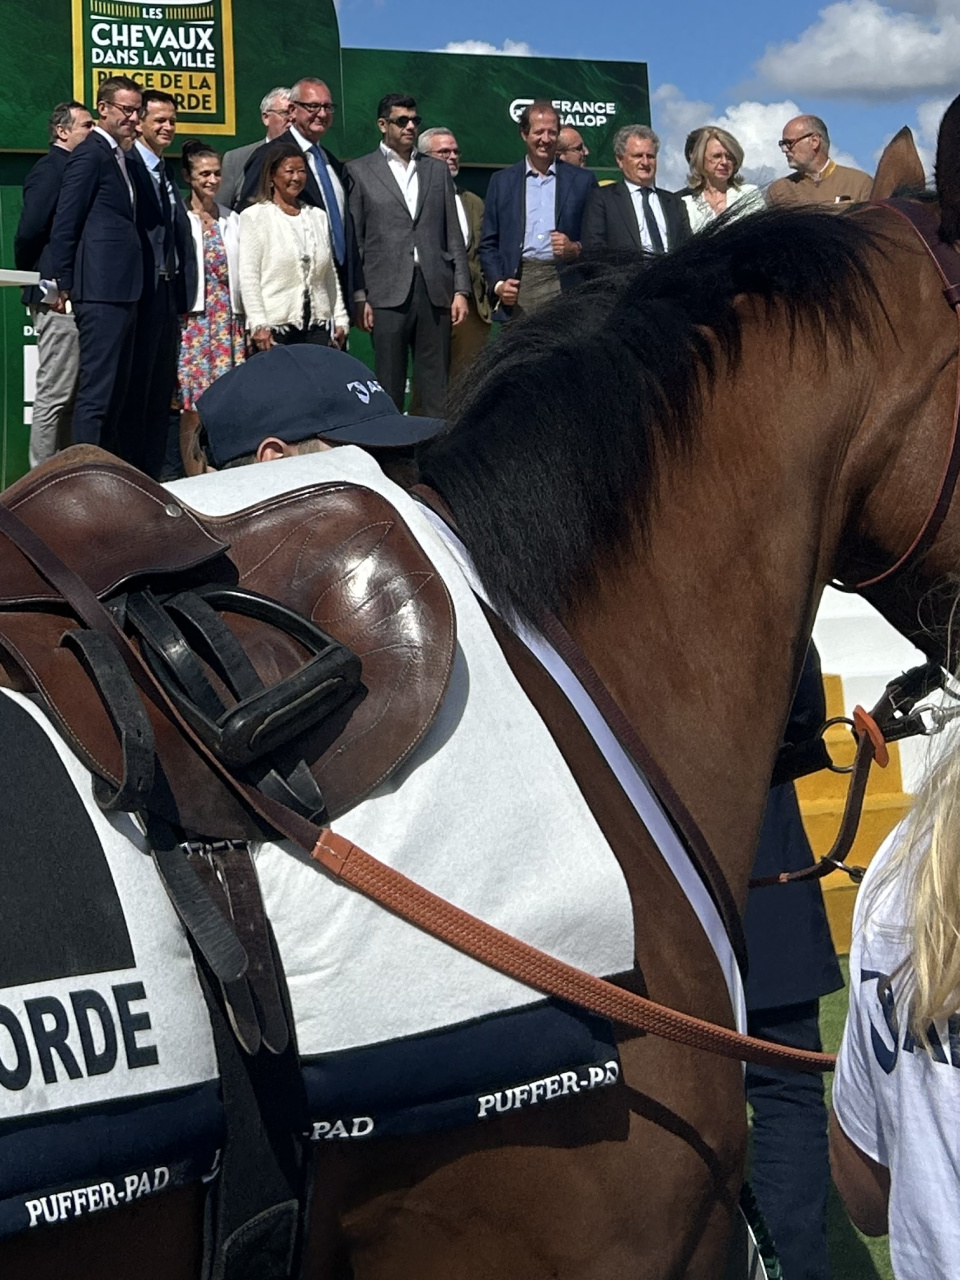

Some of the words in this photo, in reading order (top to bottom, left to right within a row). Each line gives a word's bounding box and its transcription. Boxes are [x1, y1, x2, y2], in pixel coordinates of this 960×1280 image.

[142, 7, 163, 19] LES
[91, 23, 214, 50] CHEVAUX
[92, 48, 139, 64] DANS
[143, 50, 165, 66] LA
[170, 51, 215, 68] VILLE
[98, 71, 154, 89] PCE
[161, 73, 183, 90] DE
[189, 75, 211, 91] LA
[551, 100, 616, 114] FRANCE
[25, 1167, 170, 1227] PUFFER-PAD
